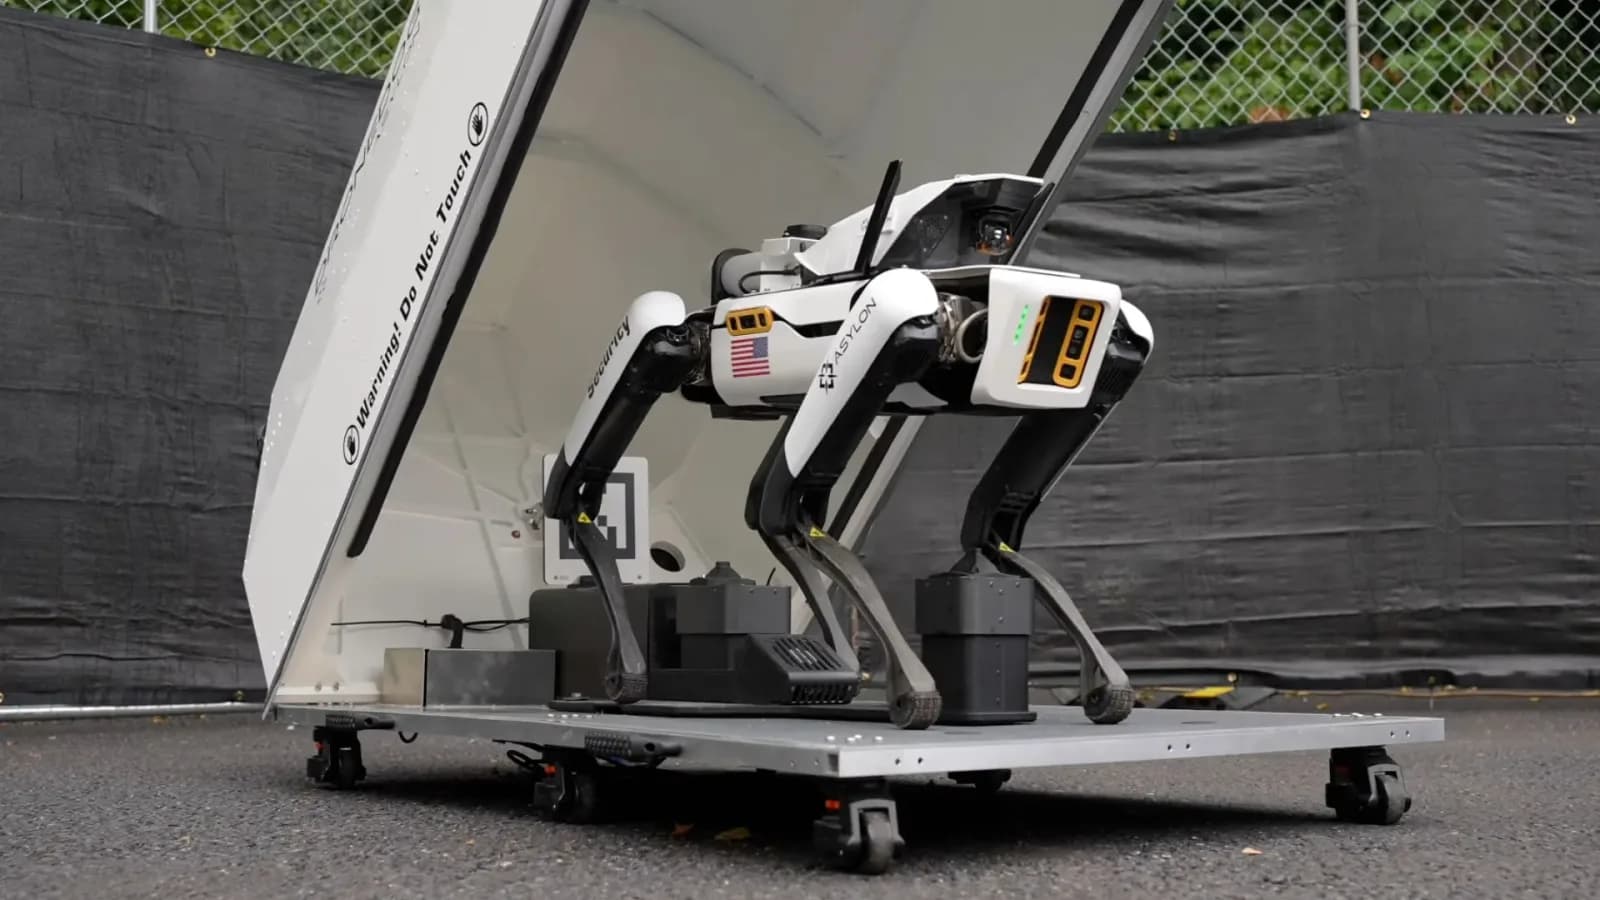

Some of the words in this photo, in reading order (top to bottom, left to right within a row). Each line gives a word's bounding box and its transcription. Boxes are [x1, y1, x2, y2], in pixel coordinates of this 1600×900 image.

[356, 321, 402, 429] Warning!
[399, 285, 418, 321] Do
[414, 230, 440, 280] Not
[436, 150, 472, 223] Touch
[834, 297, 877, 365] ASYLON
